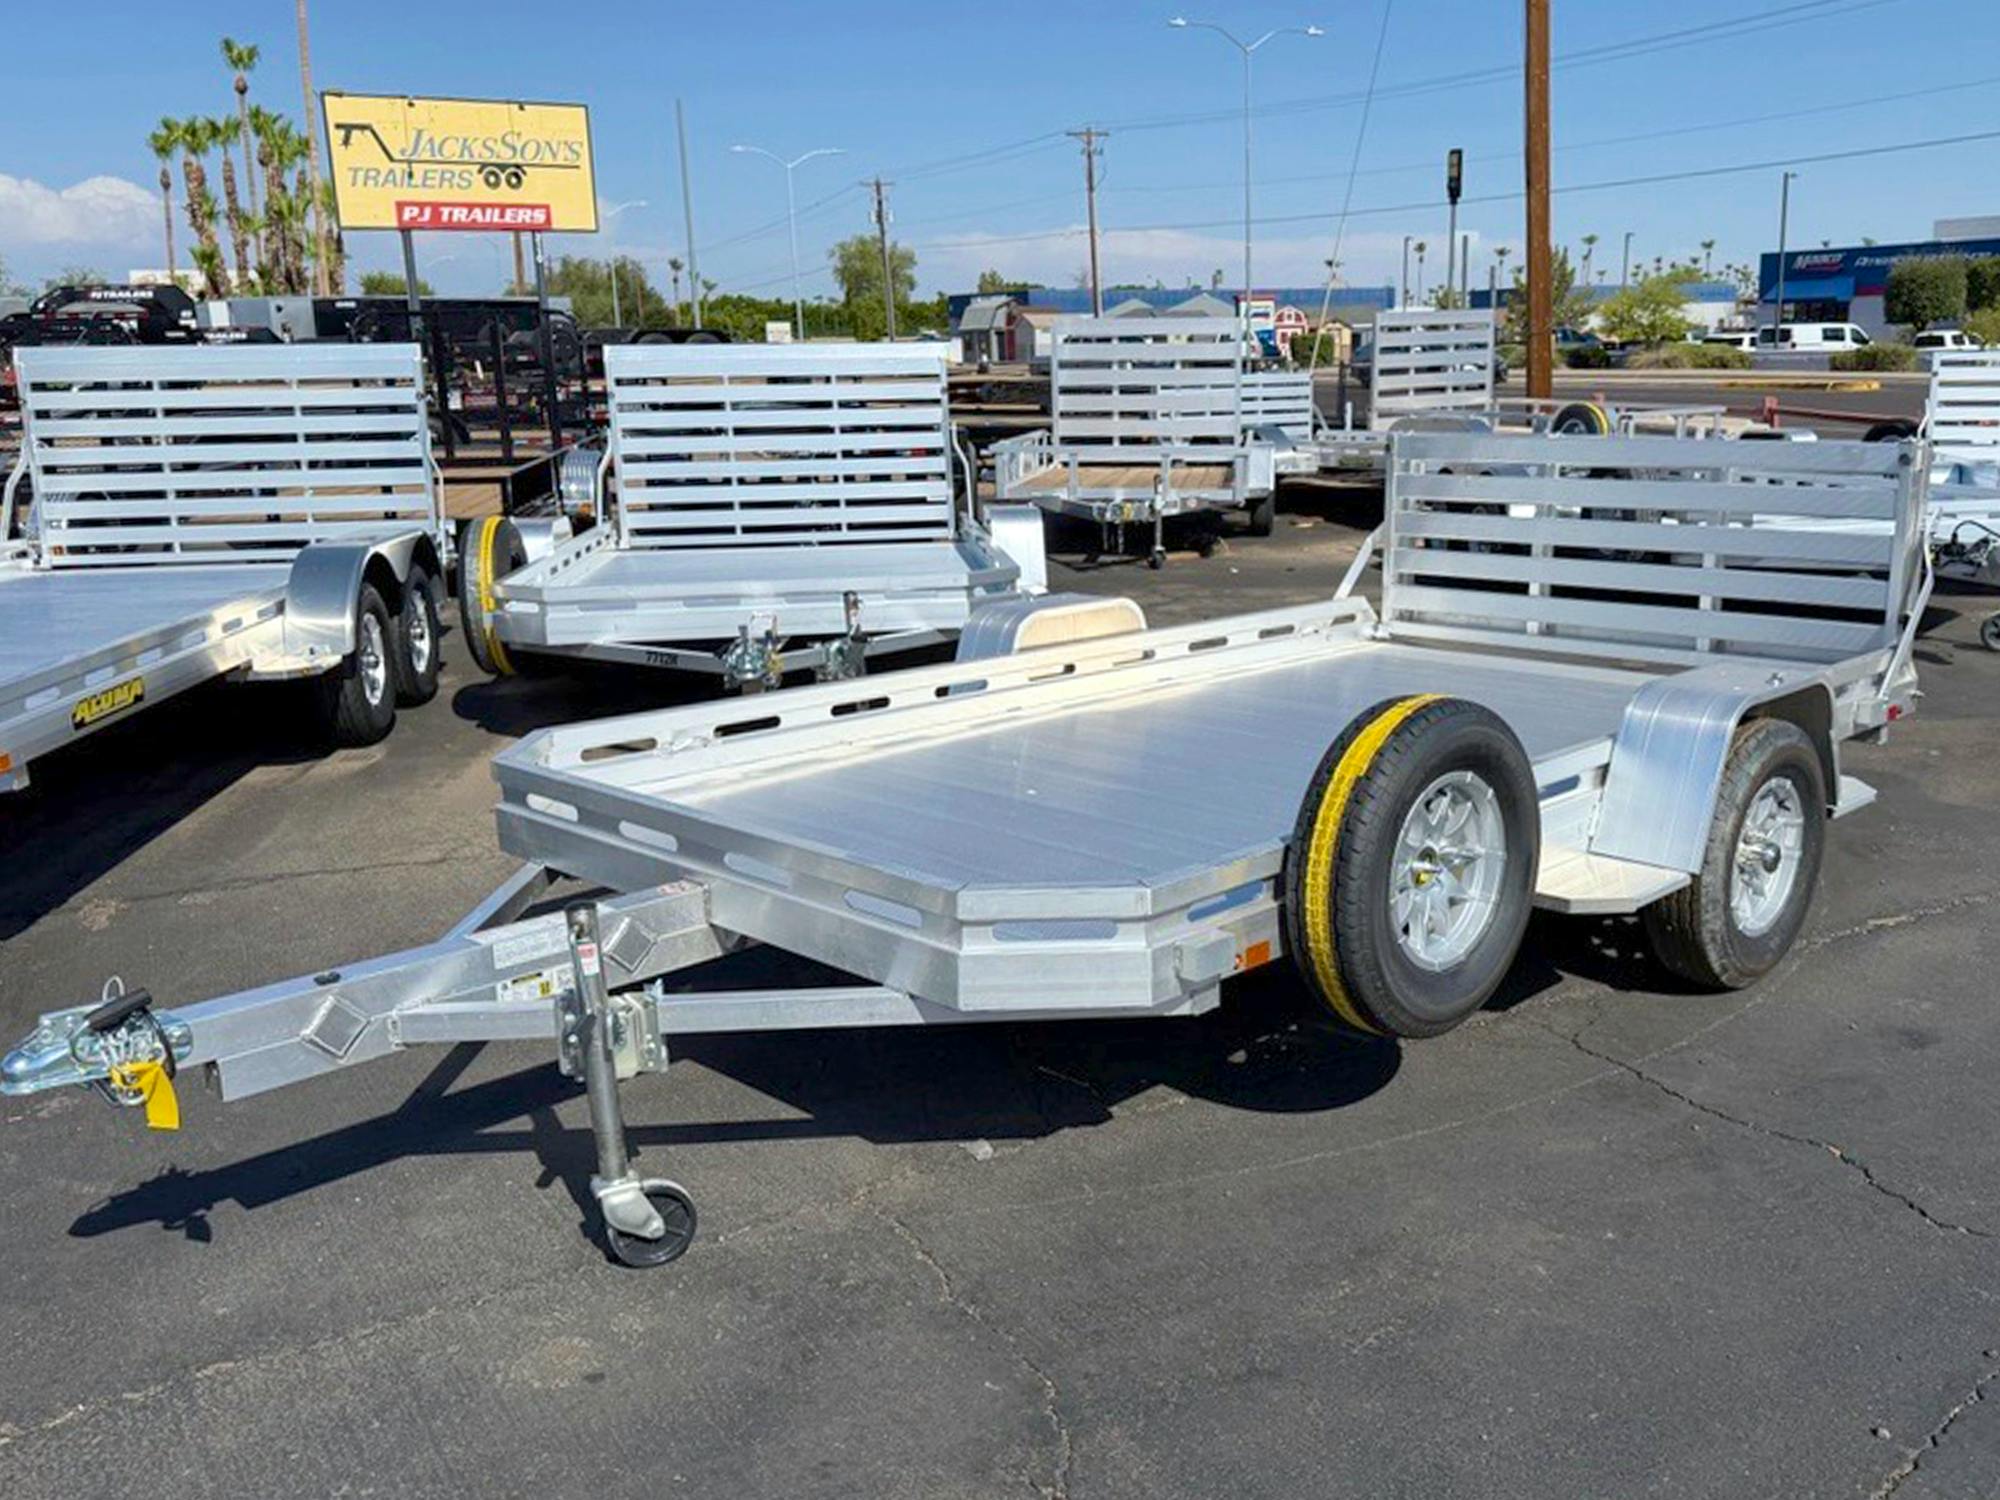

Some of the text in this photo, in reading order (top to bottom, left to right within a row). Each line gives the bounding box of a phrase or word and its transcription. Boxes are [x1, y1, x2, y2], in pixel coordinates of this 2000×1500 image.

[347, 166, 474, 190] TRAILERS
[402, 205, 547, 224] PJ TRAILERS
[74, 676, 144, 722] ALUMA
